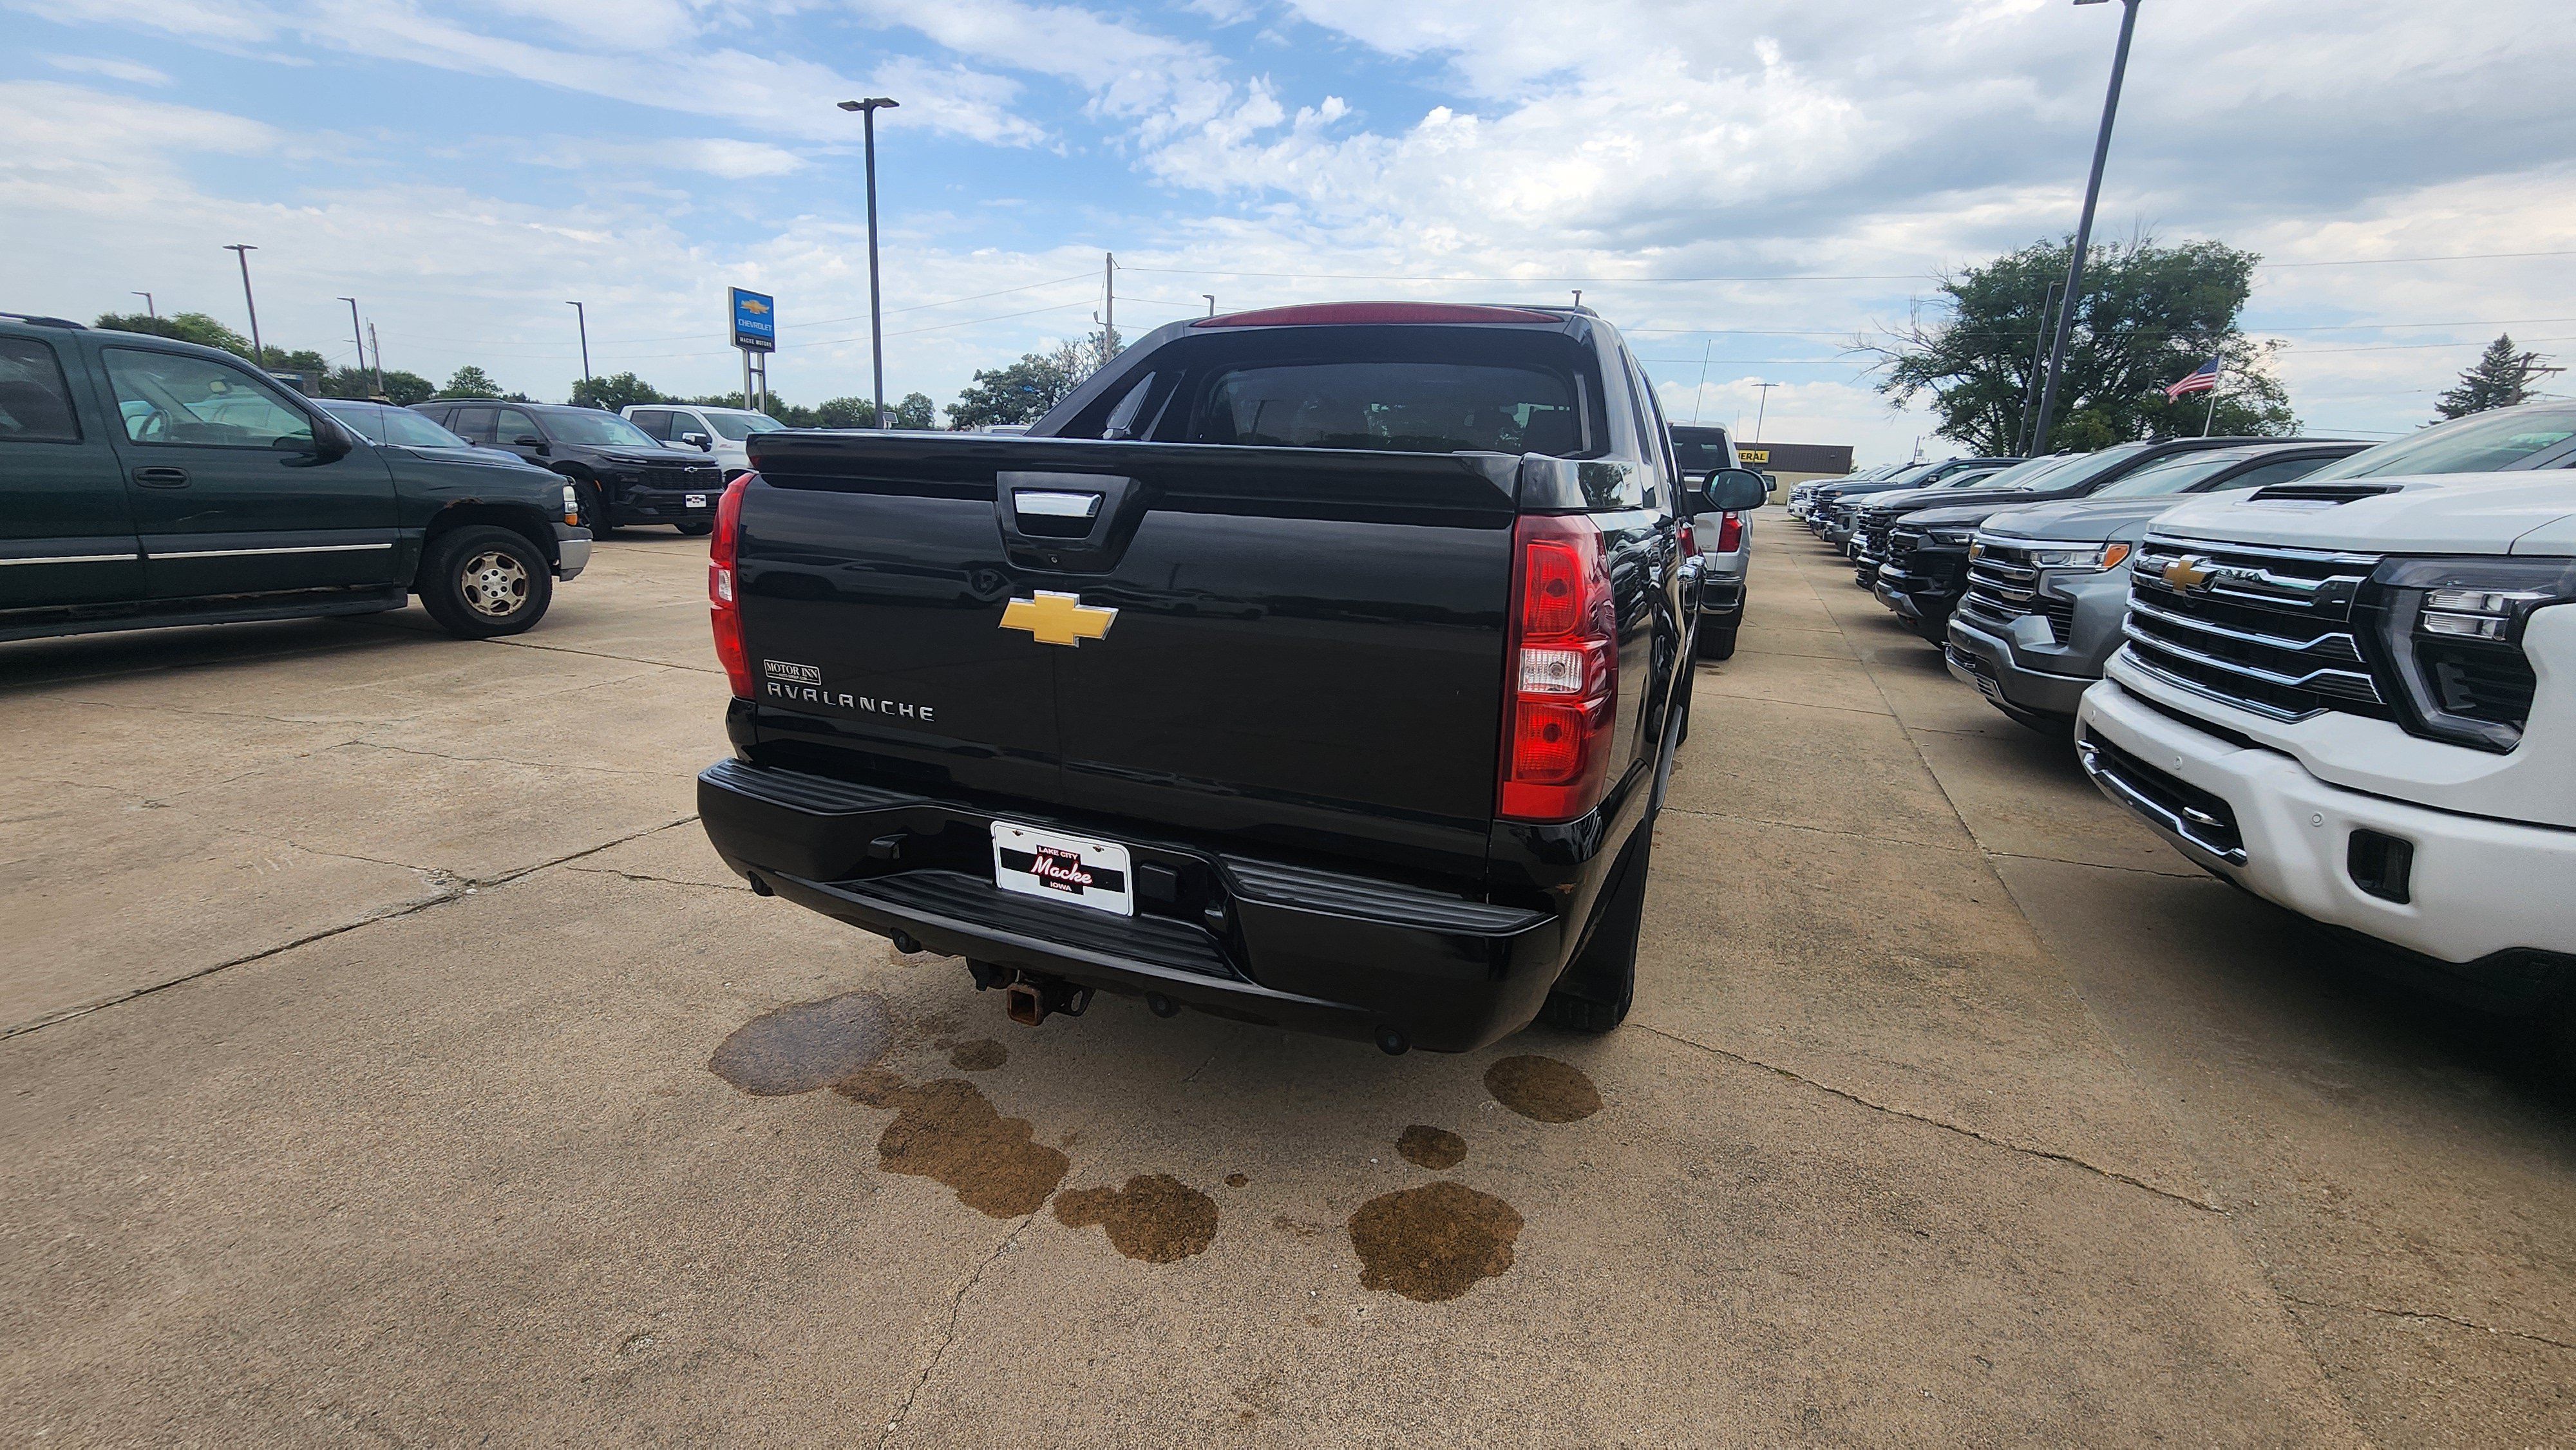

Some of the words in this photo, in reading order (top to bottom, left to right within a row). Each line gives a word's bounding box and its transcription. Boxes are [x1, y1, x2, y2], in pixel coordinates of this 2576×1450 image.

[738, 319, 772, 332] CHEVROLET
[766, 662, 800, 675] MOTOR
[801, 667, 818, 679] INN
[767, 682, 935, 722] AVALANCHE
[1038, 846, 1059, 856] LAKE
[1060, 851, 1078, 860] CITY
[1030, 856, 1093, 884] Macke
[1050, 881, 1072, 891] IOWA
